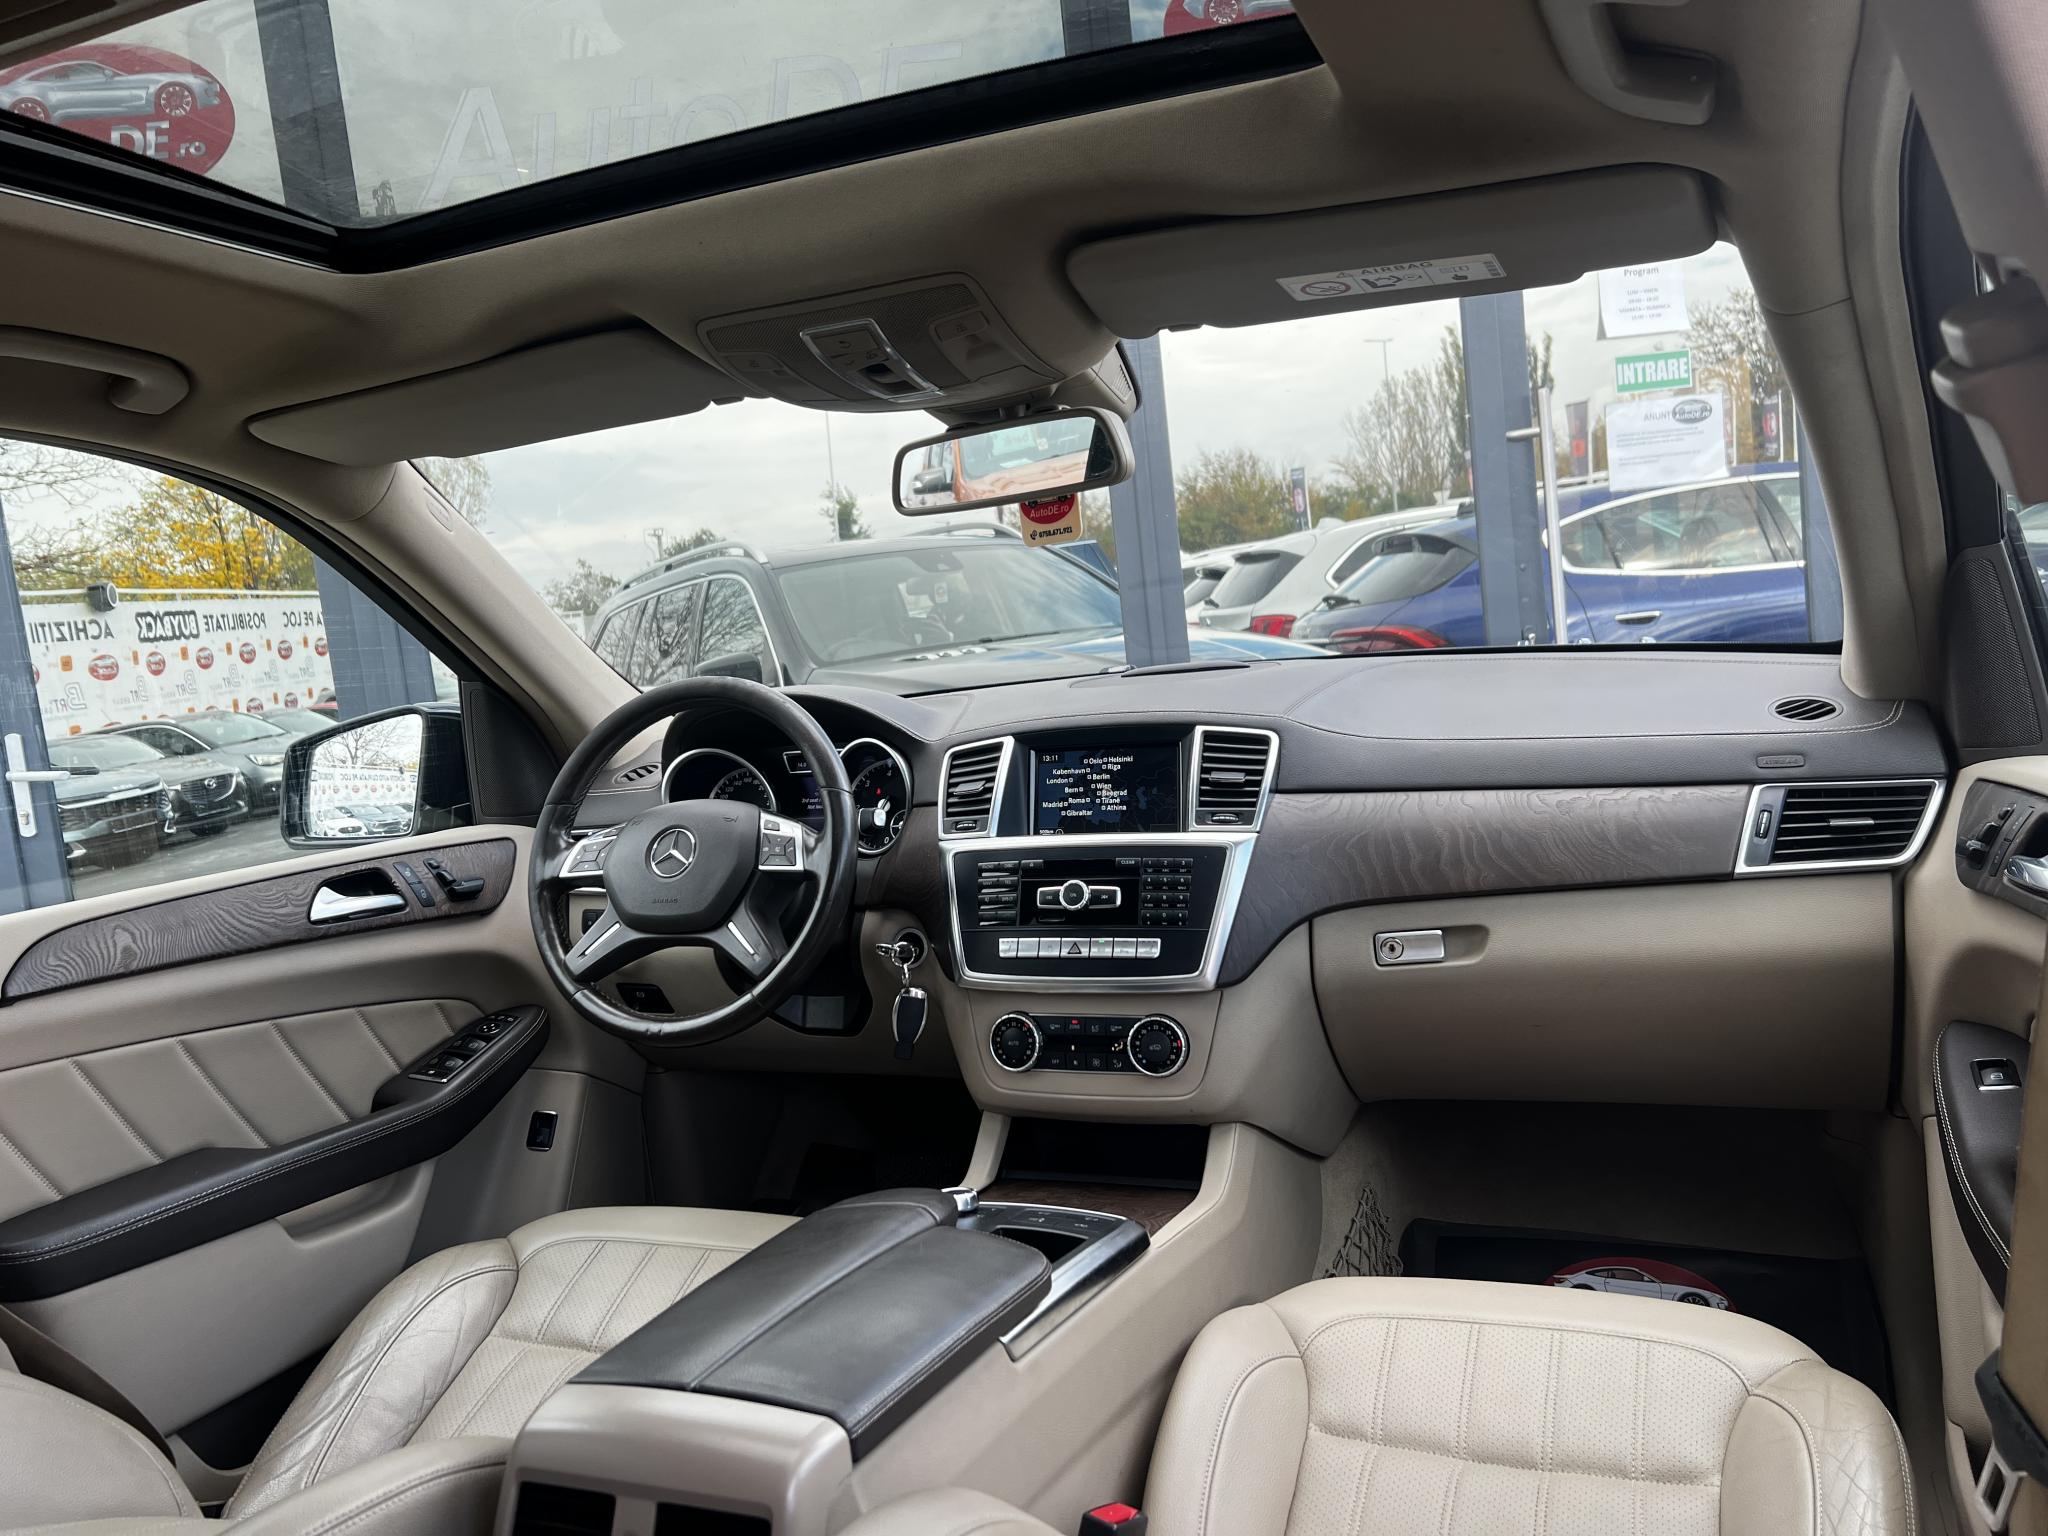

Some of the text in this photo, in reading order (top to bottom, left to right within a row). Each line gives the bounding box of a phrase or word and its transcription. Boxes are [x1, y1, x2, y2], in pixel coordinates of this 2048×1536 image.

[1361, 260, 1433, 276] AIRBAG
[1623, 266, 1660, 277] Program
[1616, 357, 1689, 386] INTRARE
[1030, 504, 1070, 518] AutoDE.ro
[1089, 757, 1103, 765] Oslo
[1108, 755, 1133, 763] Helsinki
[1107, 763, 1121, 771] Riga
[1096, 782, 1112, 790] Wien
